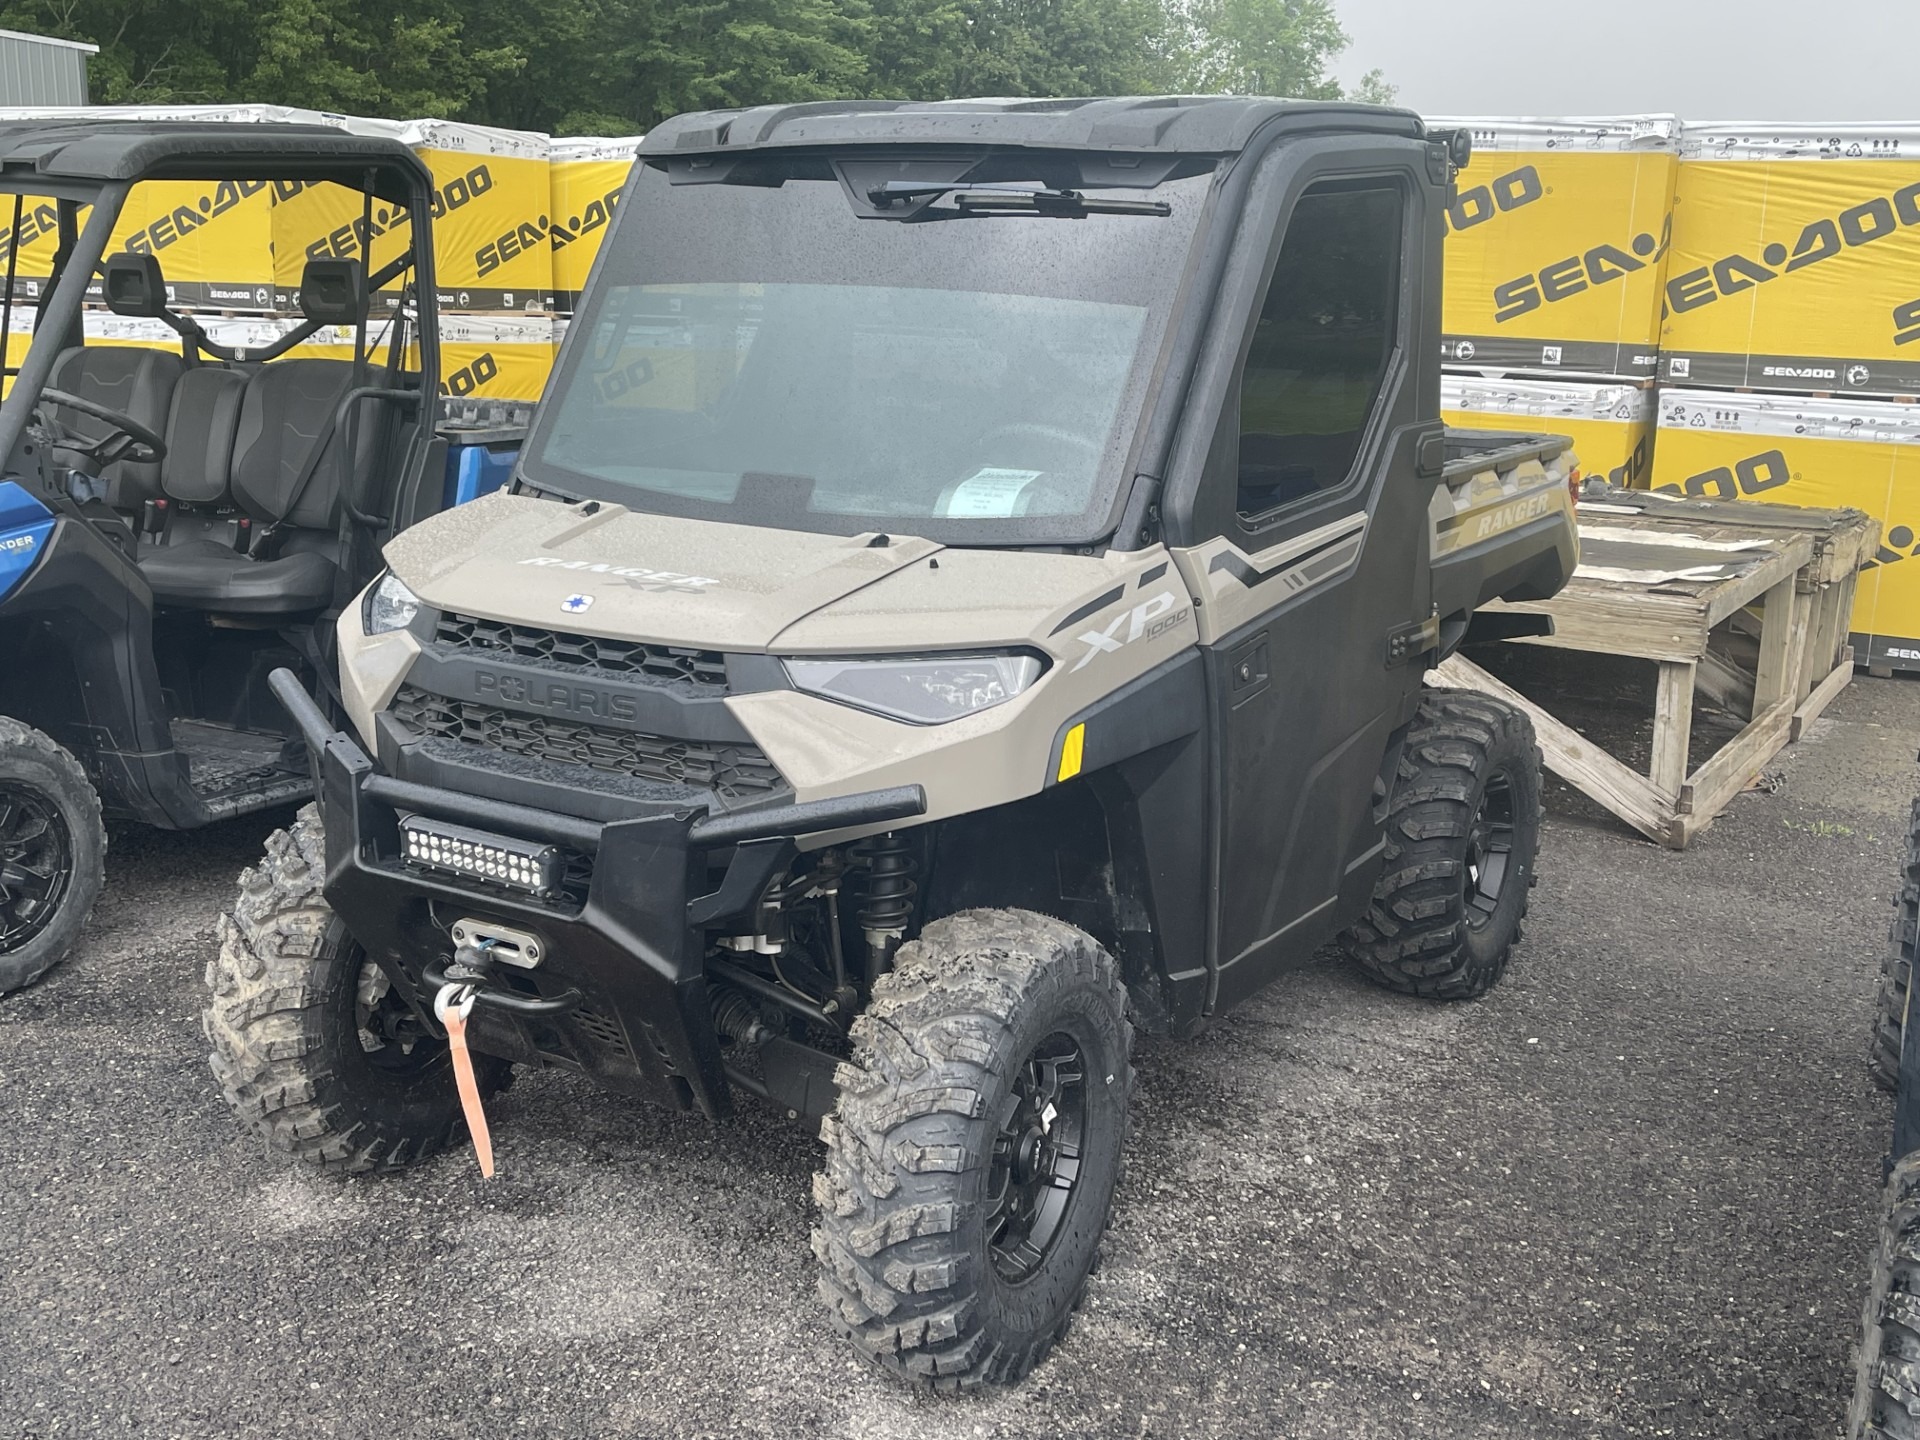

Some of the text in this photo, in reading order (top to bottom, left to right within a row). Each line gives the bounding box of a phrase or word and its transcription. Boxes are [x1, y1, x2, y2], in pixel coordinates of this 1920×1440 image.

[1443, 165, 1543, 237] OO
[1653, 449, 1791, 500] OO
[1477, 493, 1549, 538] RANGER
[516, 557, 721, 587] RANGER
[600, 578, 707, 595] XP
[1068, 591, 1176, 674] XP
[1146, 608, 1188, 638] 1000
[474, 670, 638, 723] POLARIS
